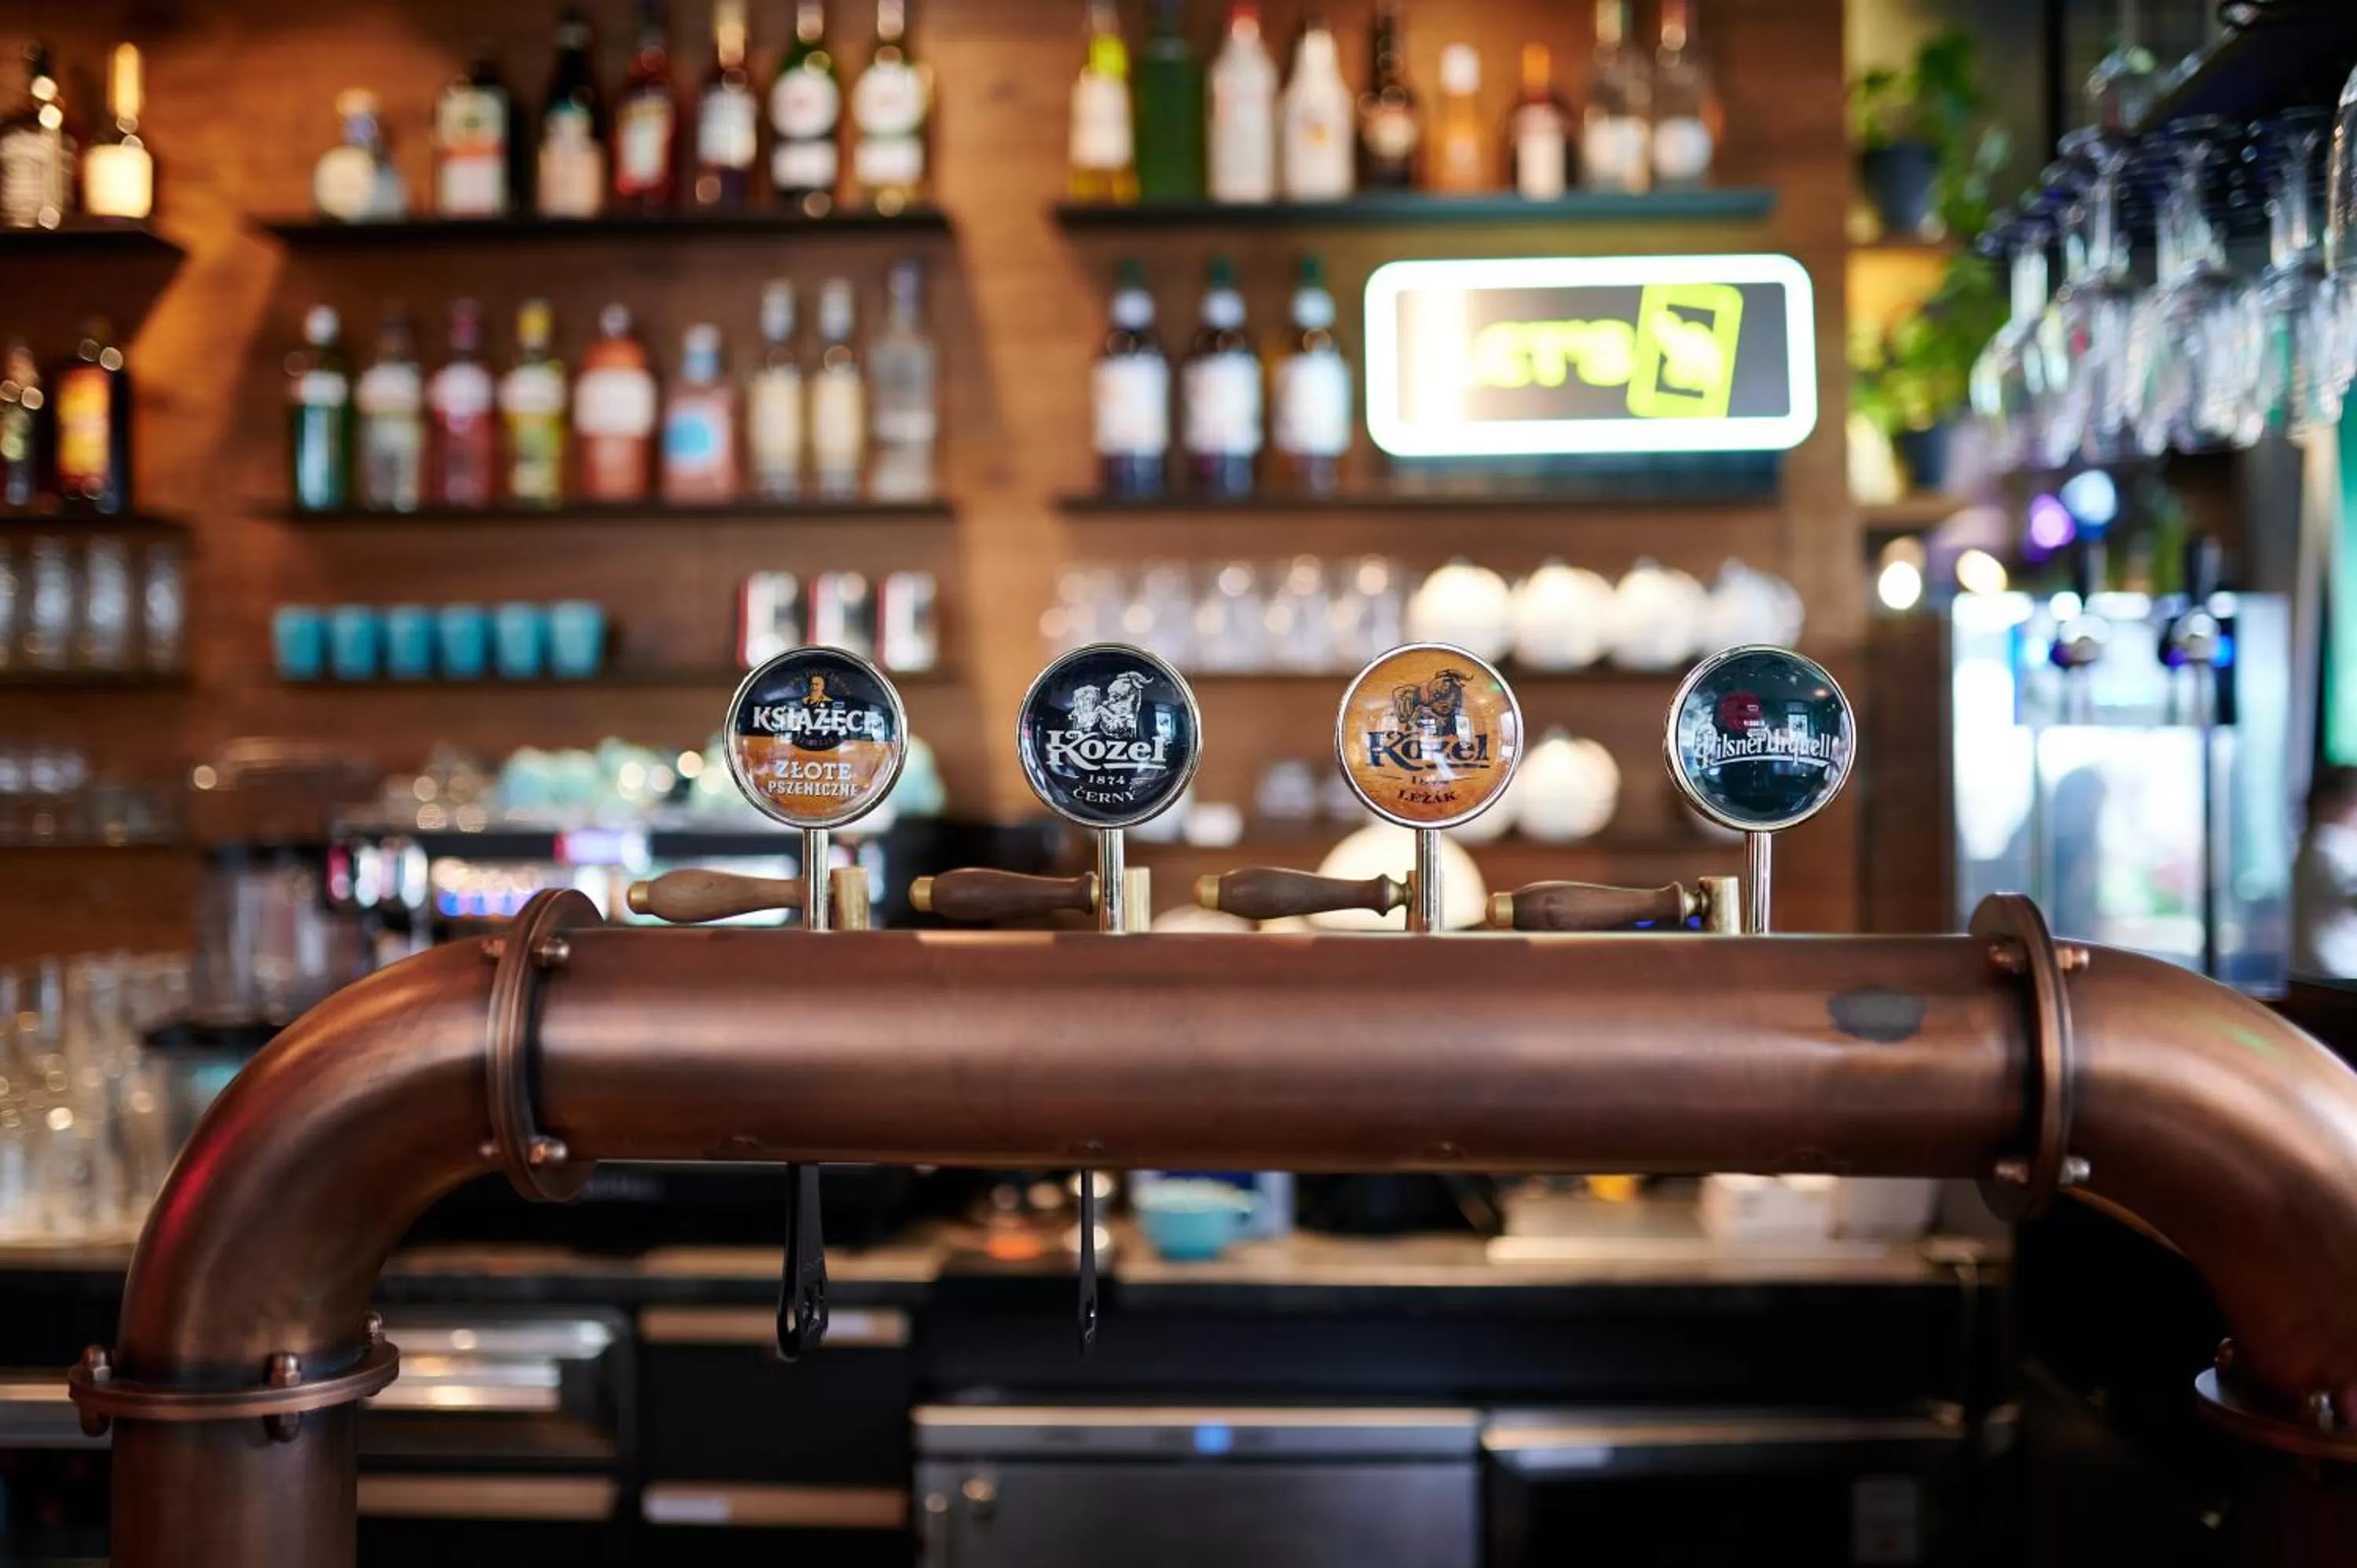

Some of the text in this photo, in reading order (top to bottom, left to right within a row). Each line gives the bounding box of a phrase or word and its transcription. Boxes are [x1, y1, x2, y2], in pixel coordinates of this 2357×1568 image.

[1046, 730, 1167, 771] Kozel
[1693, 724, 1766, 769] Pilsner
[775, 760, 852, 780] ZŁOTE
[1089, 775, 1125, 785] 1874
